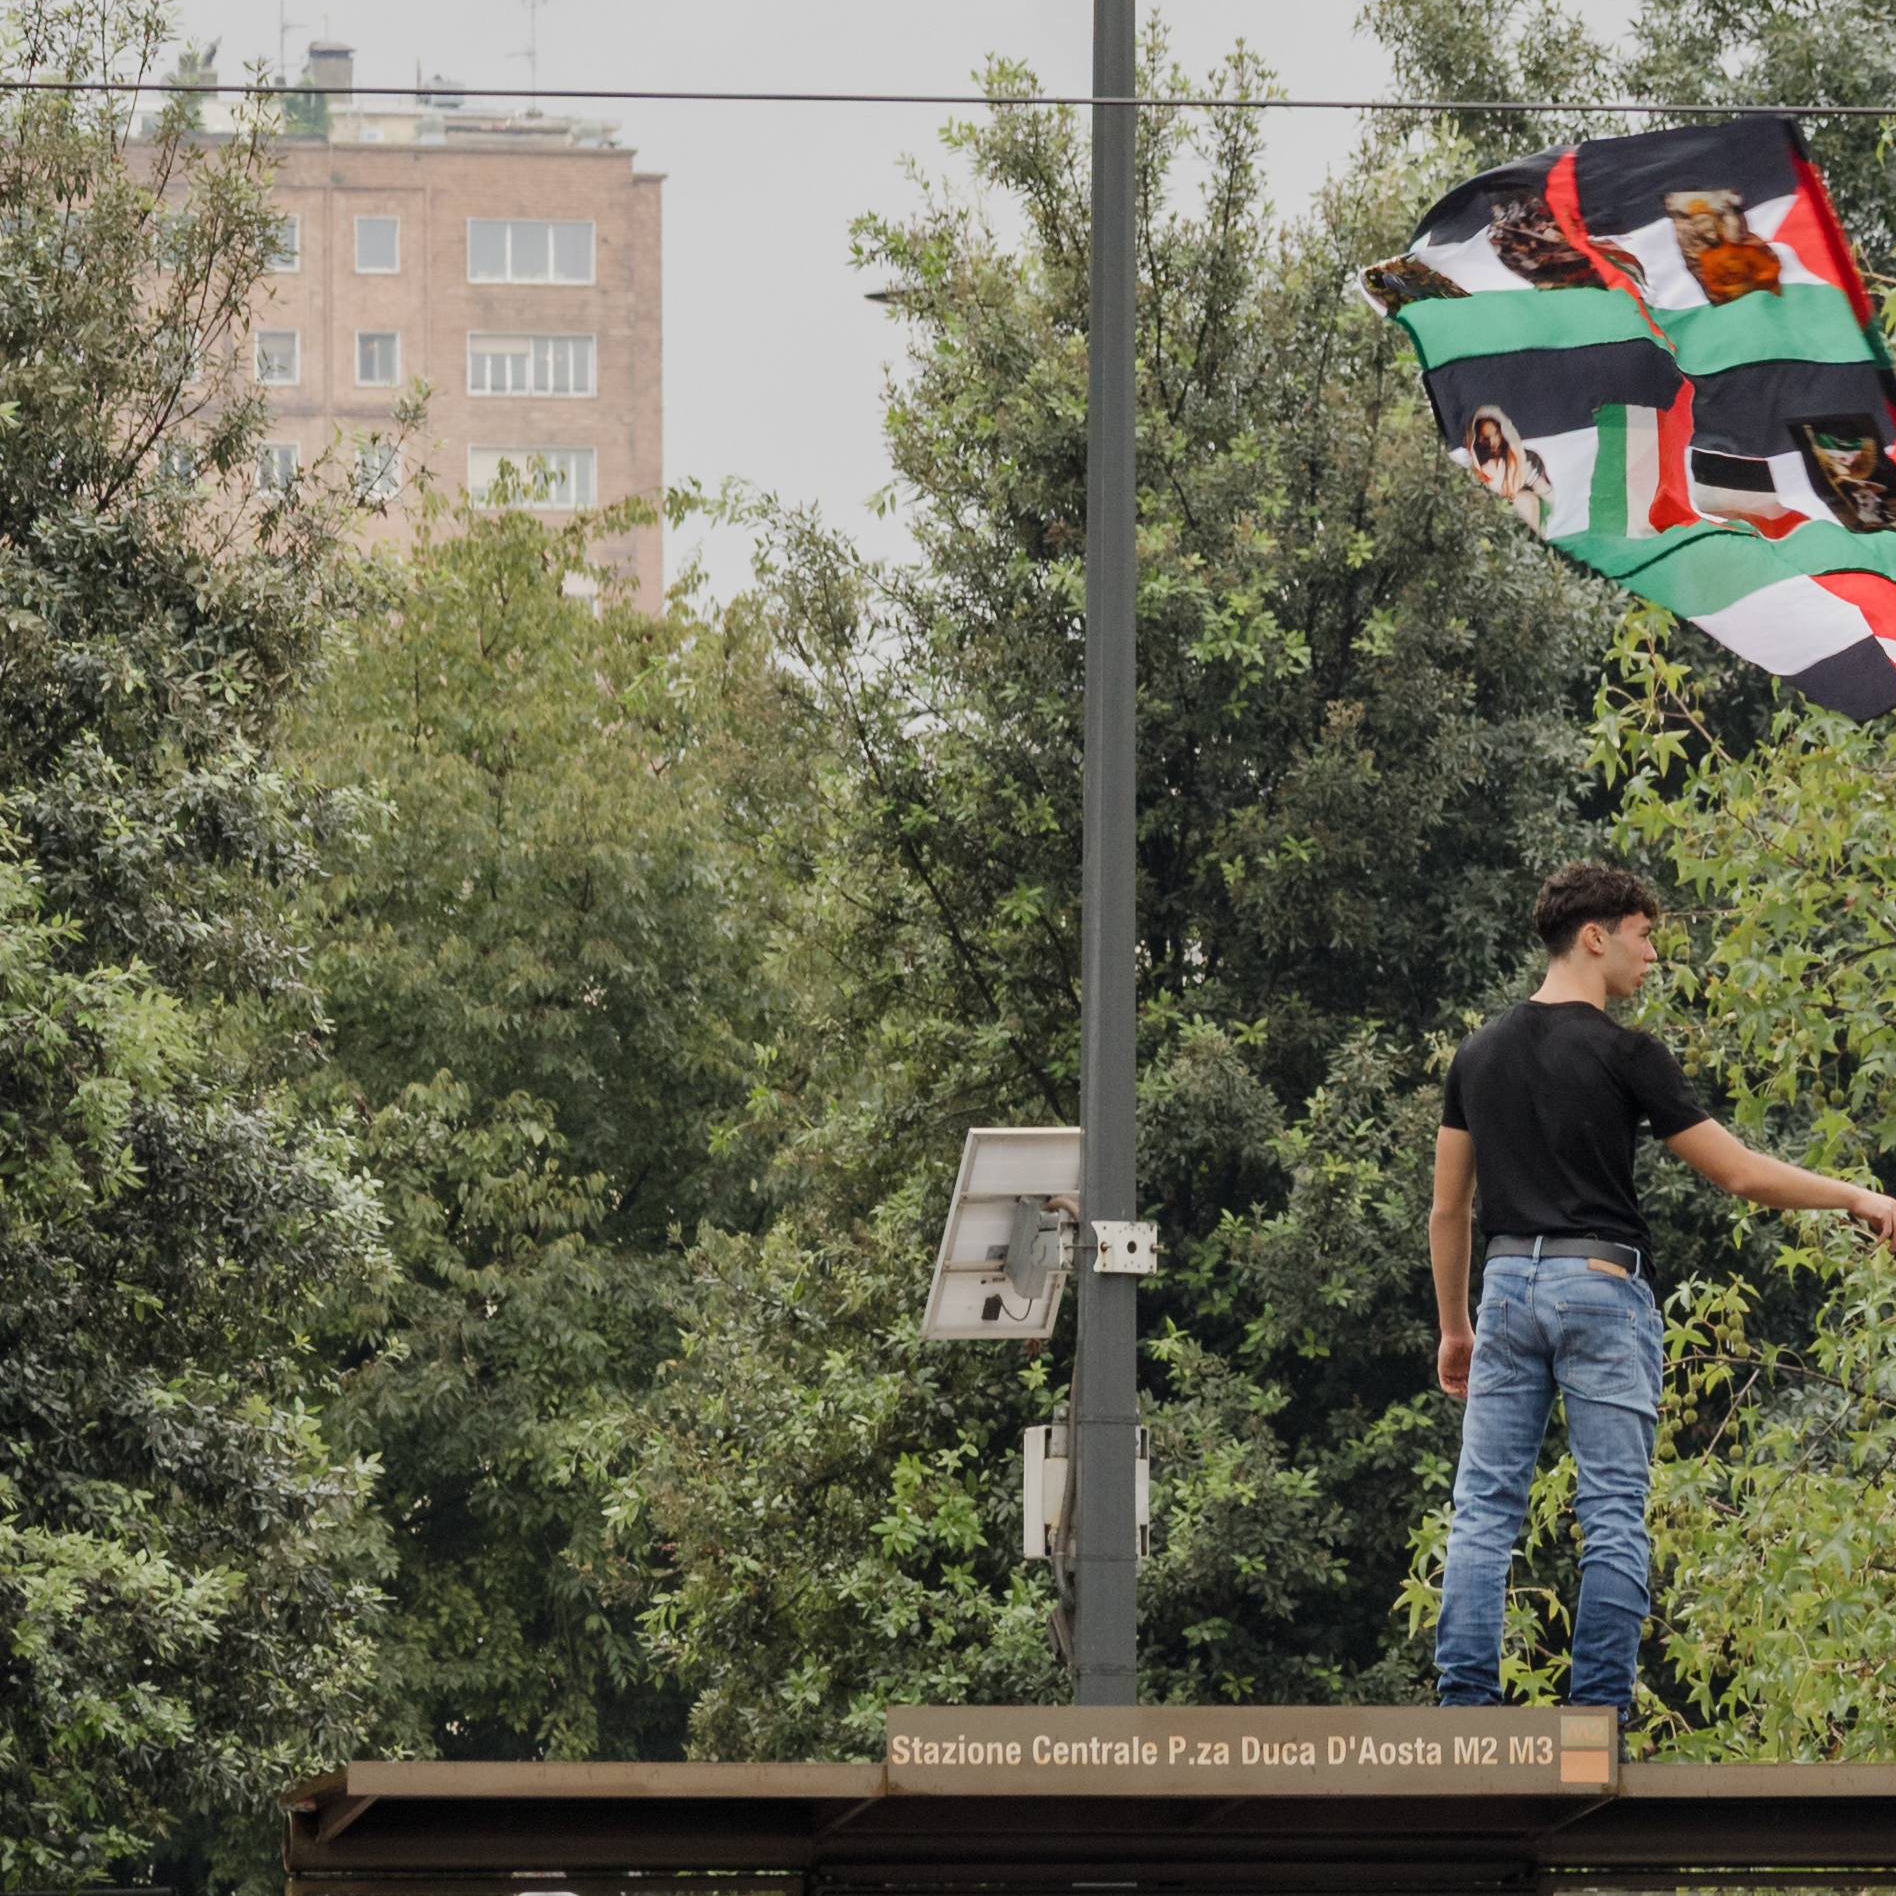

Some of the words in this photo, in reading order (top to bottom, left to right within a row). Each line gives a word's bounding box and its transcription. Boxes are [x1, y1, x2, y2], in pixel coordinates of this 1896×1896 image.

[1566, 1720, 1604, 1741] M2
[892, 1734, 1022, 1765] Stazione
[1032, 1734, 1158, 1765] Centrale
[1168, 1735, 1230, 1765] P.za
[1241, 1736, 1316, 1765] Duca
[1327, 1736, 1442, 1765] D'Aosta
[1453, 1736, 1498, 1765] M2
[1509, 1736, 1553, 1765] M3
